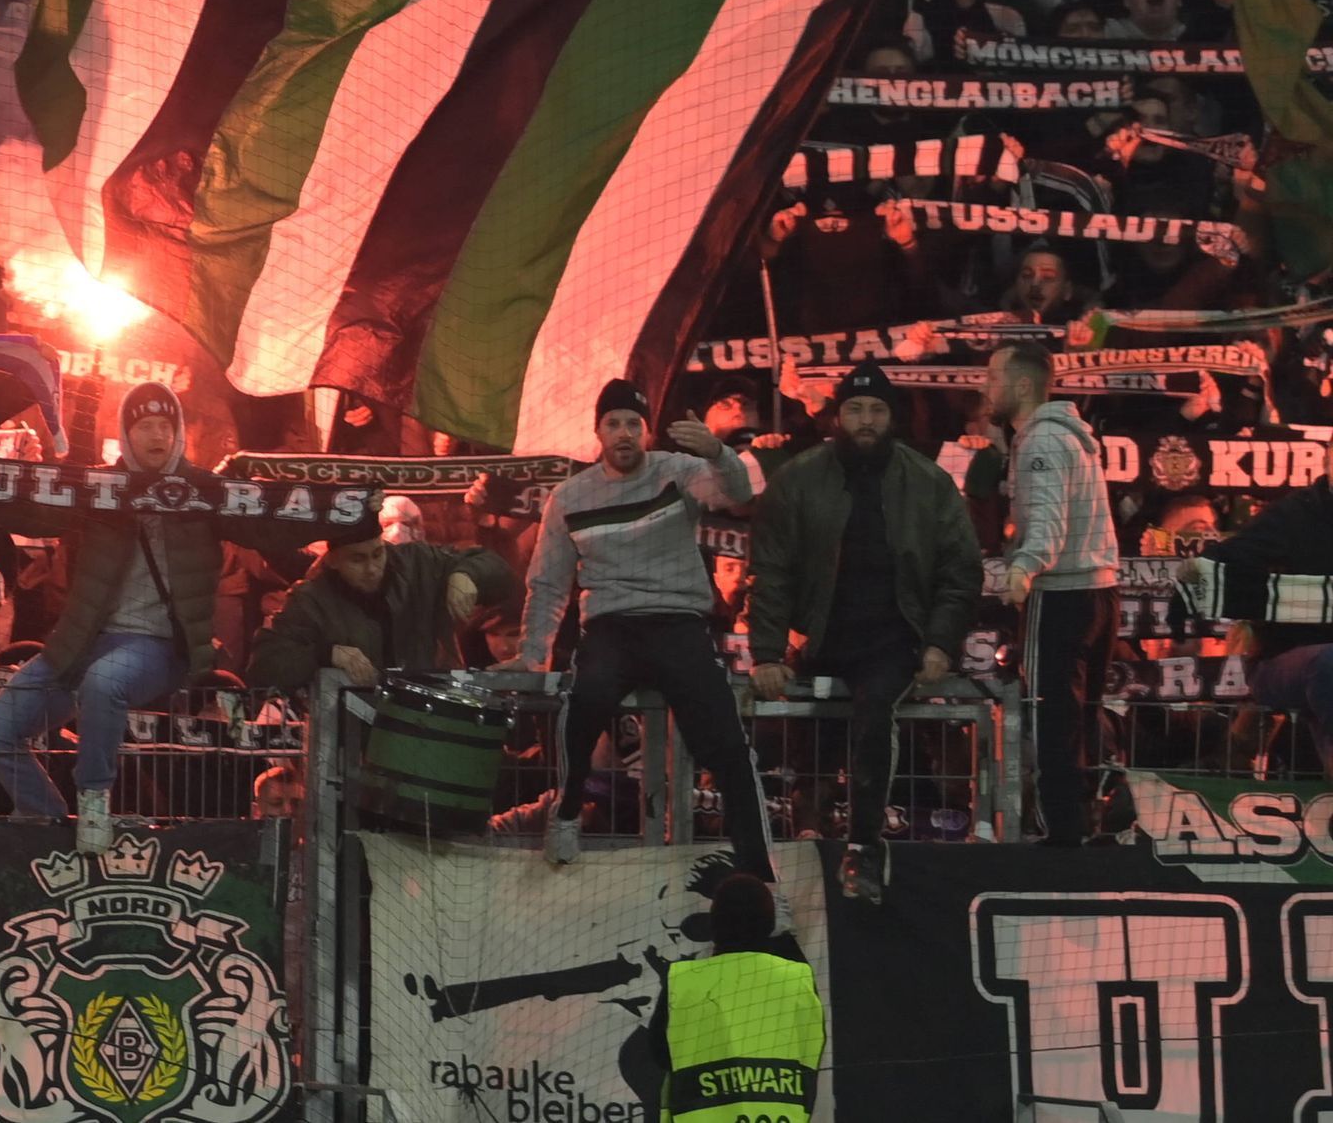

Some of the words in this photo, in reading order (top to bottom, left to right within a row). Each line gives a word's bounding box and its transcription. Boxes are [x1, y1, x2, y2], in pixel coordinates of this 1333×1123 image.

[248, 457, 573, 488] ASCENDENTE
[87, 892, 174, 920] NORD
[429, 1053, 576, 1096] rabauke
